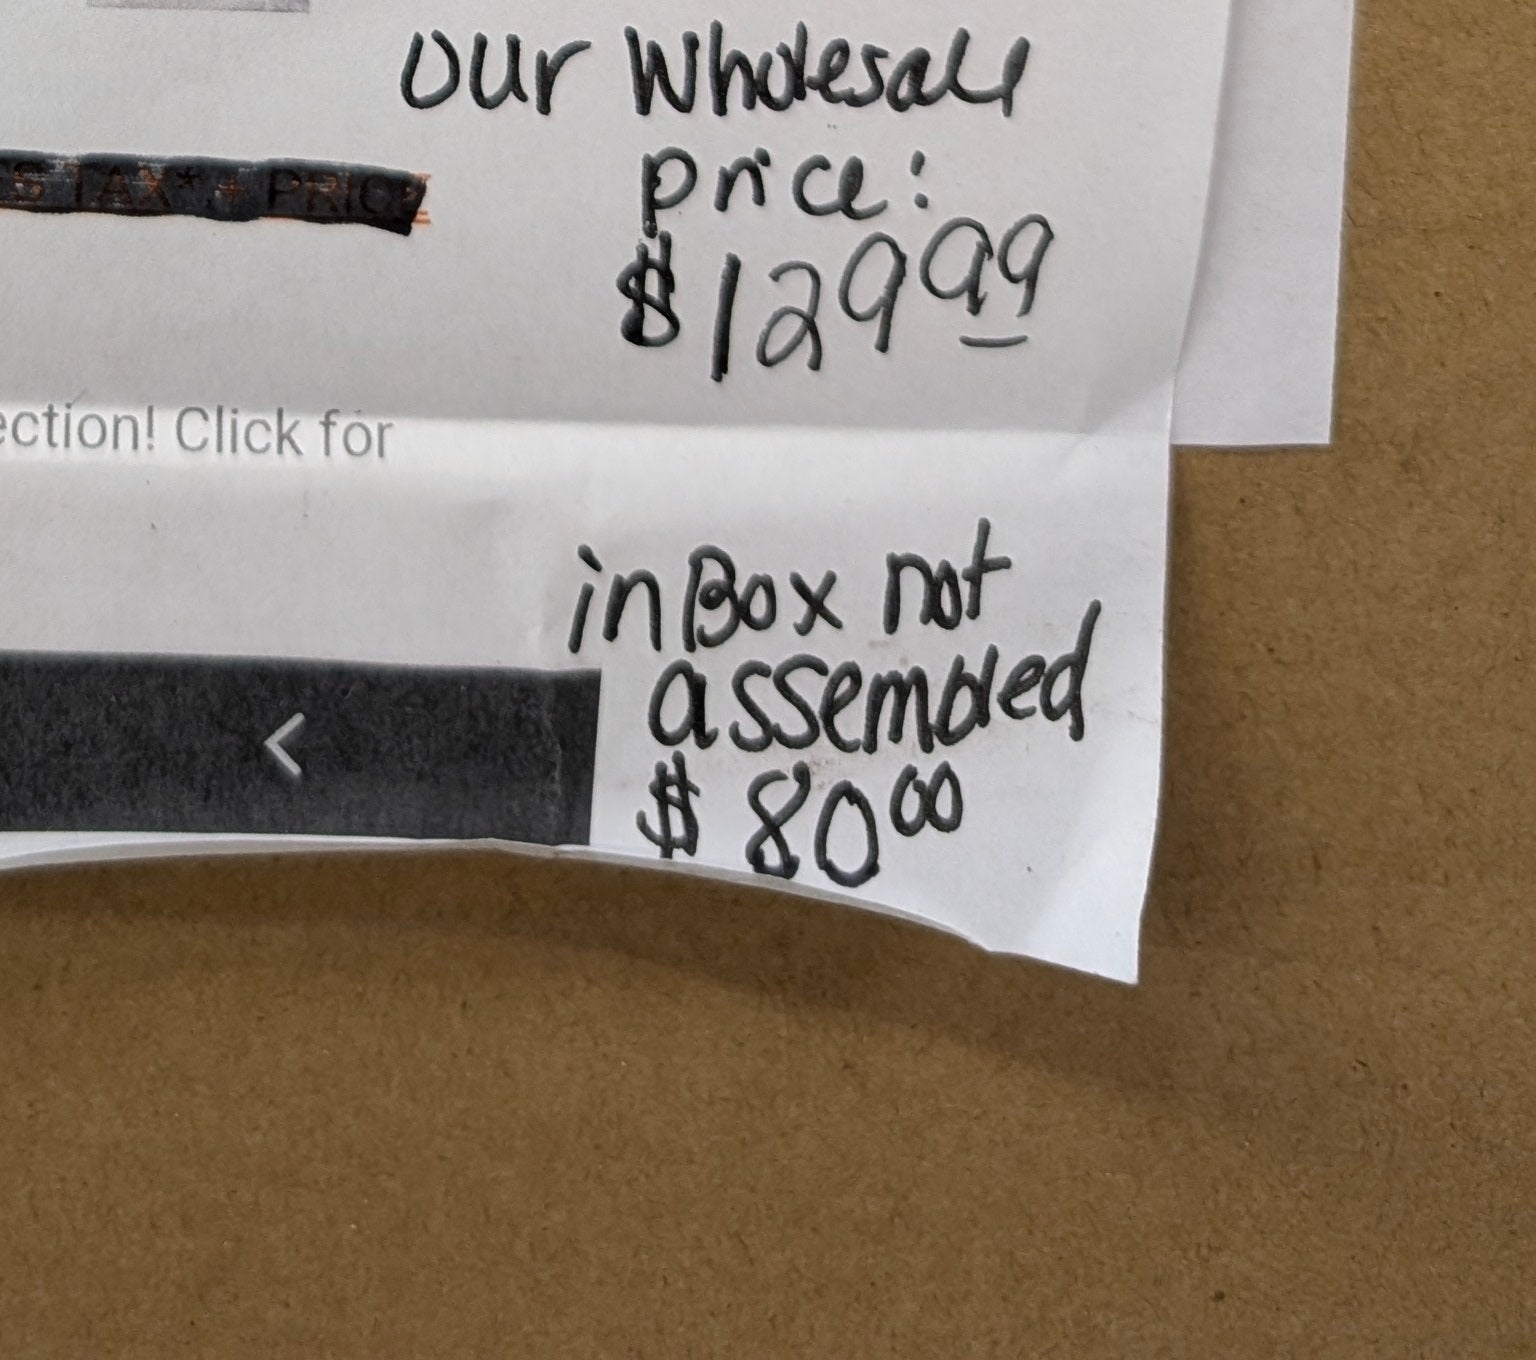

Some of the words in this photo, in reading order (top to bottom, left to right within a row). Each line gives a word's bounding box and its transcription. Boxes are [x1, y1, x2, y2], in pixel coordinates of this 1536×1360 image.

[176, 405, 303, 456] Click
[320, 408, 393, 459] for
[883, 518, 1012, 636] not
